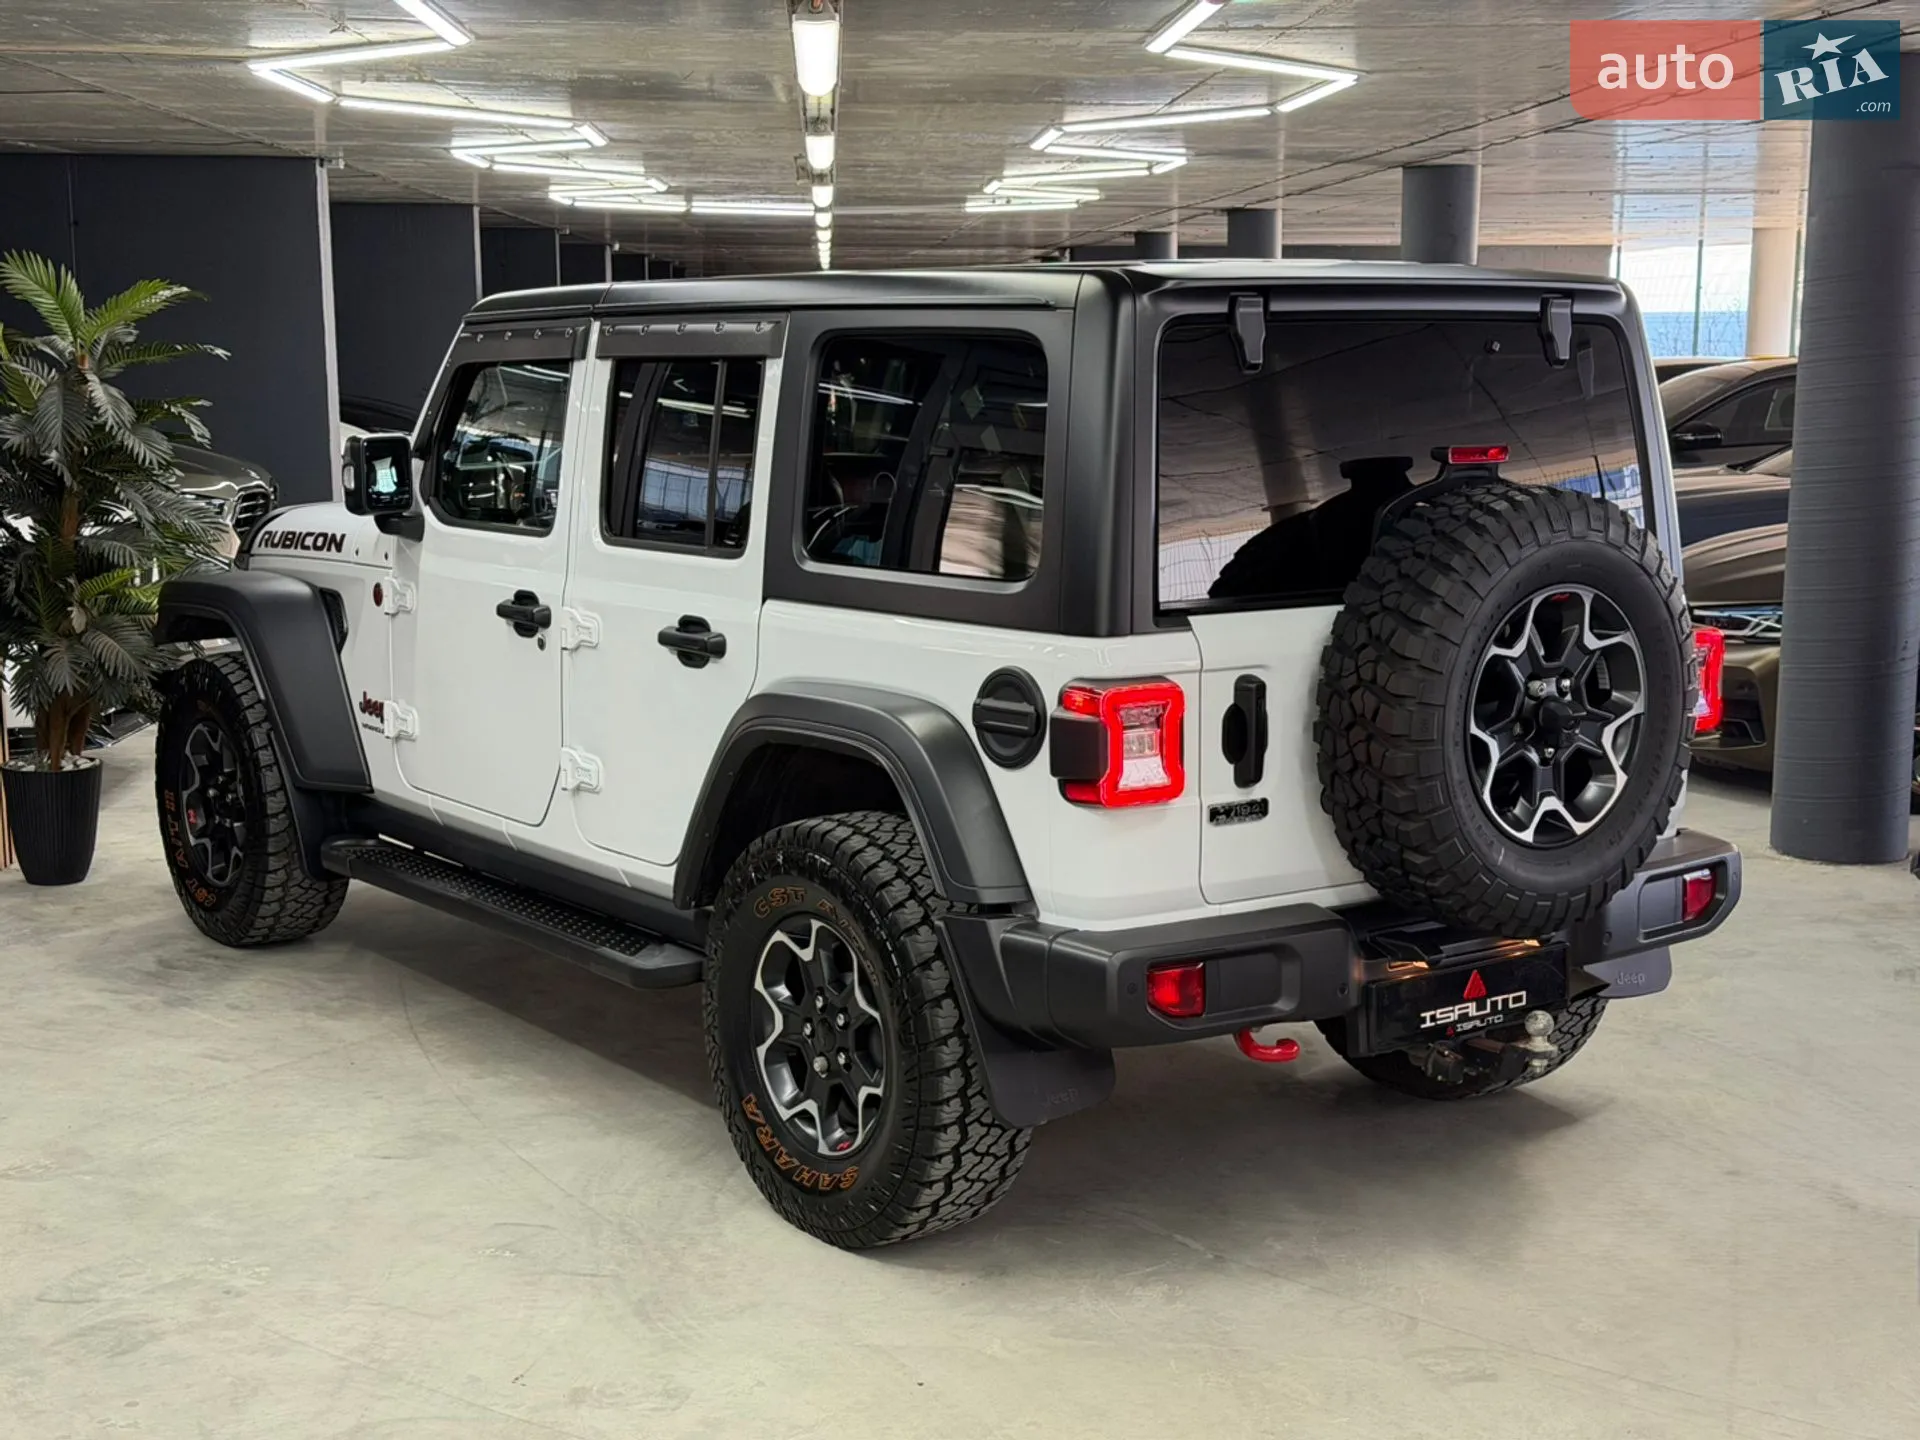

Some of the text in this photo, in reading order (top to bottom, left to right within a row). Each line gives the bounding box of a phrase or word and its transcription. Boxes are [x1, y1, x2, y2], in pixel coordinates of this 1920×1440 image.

[258, 530, 346, 553] RUBICON
[753, 884, 808, 920] CST
[1616, 971, 1646, 987] Jeep
[1419, 990, 1528, 1029] ISAUTO
[1455, 1013, 1505, 1033] ISAUTO
[741, 1091, 860, 1191] SAHARA
